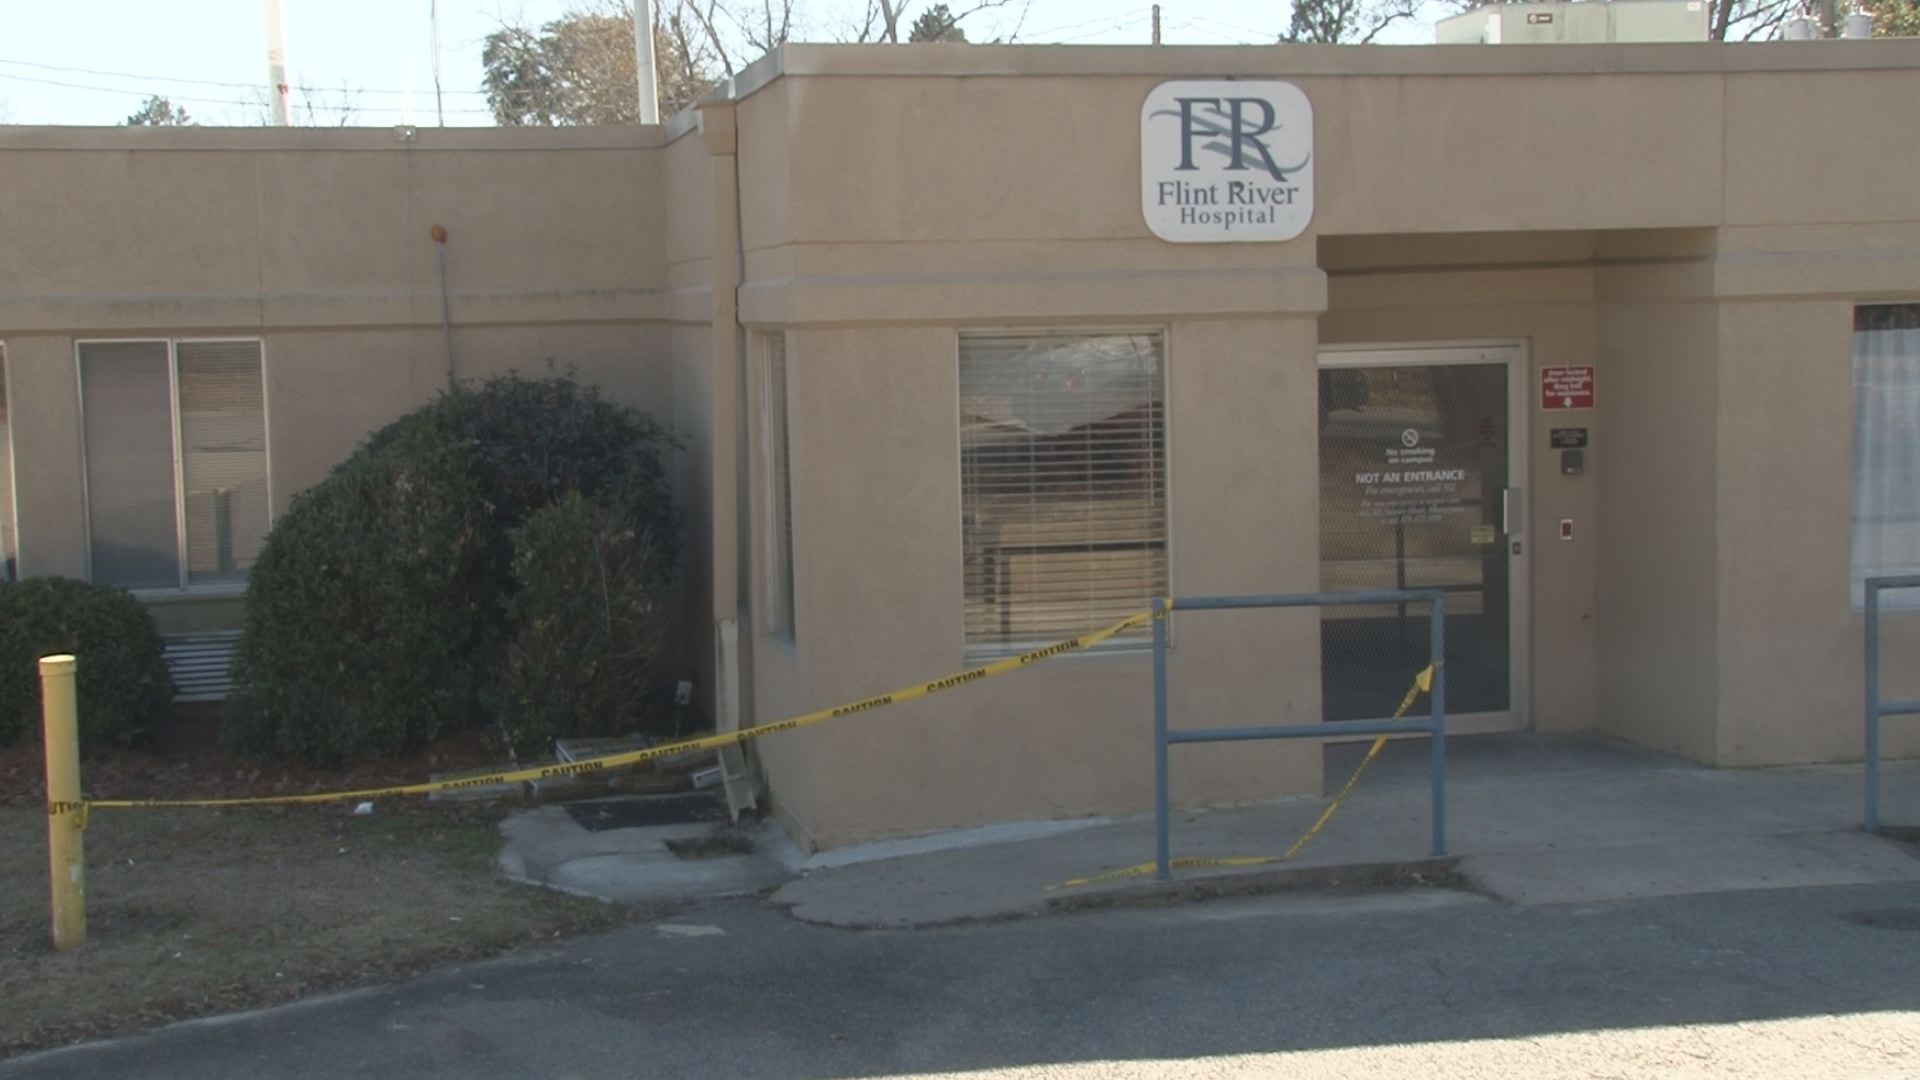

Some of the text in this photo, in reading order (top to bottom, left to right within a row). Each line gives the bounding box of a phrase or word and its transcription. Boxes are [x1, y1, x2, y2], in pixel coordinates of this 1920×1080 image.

[1173, 97, 1289, 182] FR
[1157, 180, 1300, 206] Flint River
[1180, 205, 1276, 231] Hospital
[1385, 448, 1436, 457] No smoking
[1356, 470, 1466, 484] NOT AN ENTRANCE
[1020, 639, 1080, 664] CAUTION
[926, 669, 987, 692] CAUTION
[832, 696, 892, 718] CAUTION
[737, 720, 797, 741] CAUTION
[639, 742, 701, 760] CAUTION
[541, 761, 604, 777] CAUTION
[441, 776, 504, 789] CAUTION
